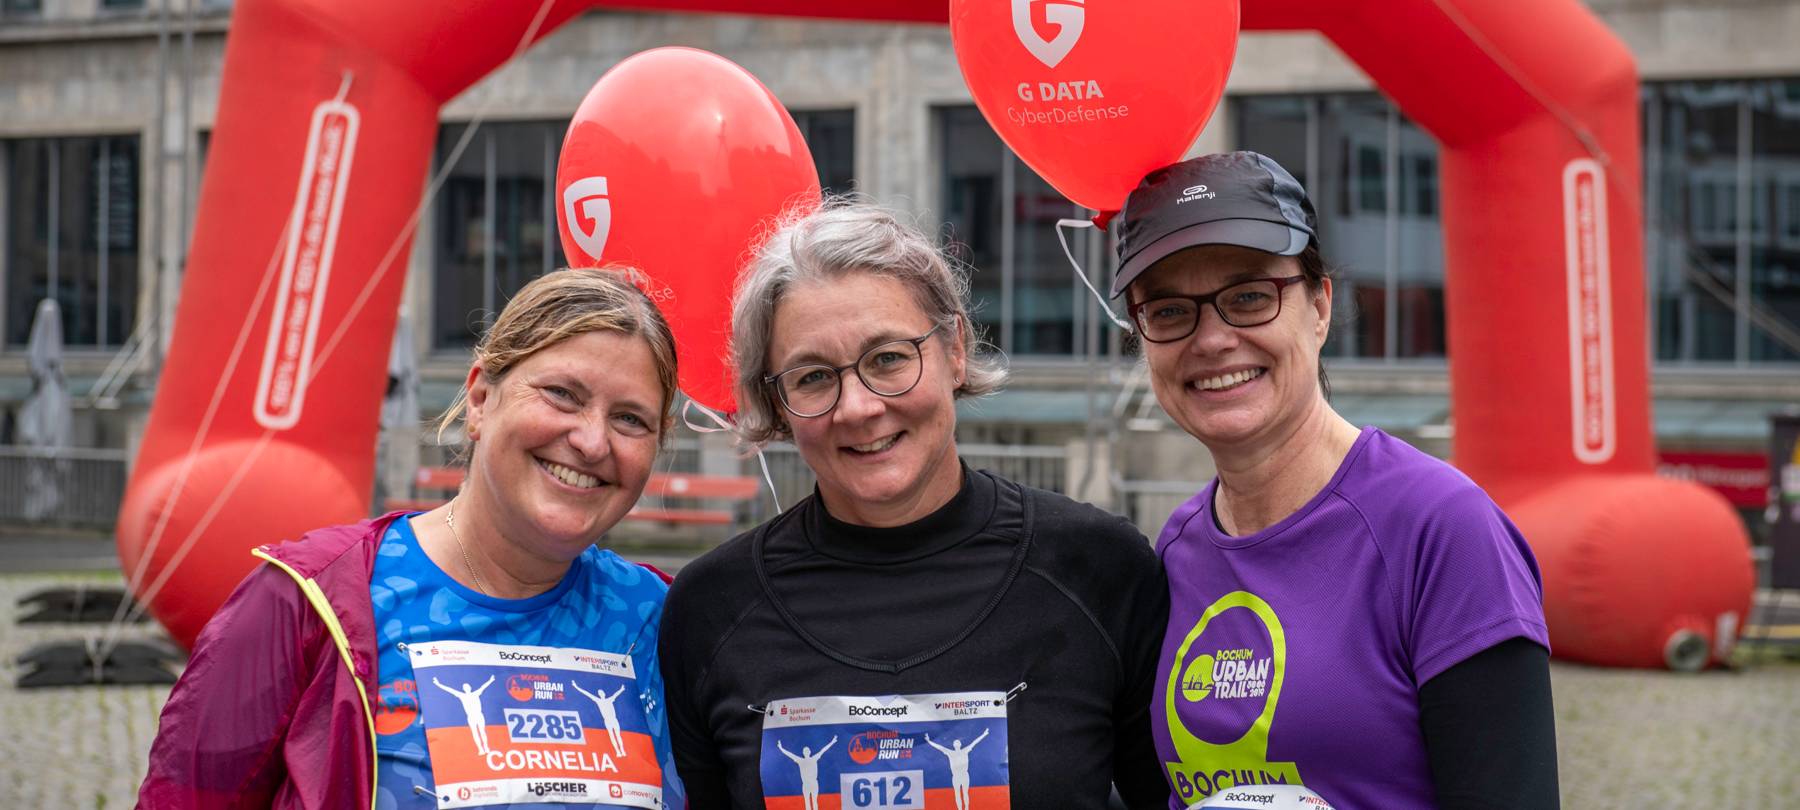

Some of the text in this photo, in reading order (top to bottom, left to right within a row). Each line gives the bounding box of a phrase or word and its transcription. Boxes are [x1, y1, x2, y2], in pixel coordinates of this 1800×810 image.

[1017, 79, 1104, 102] G DATA
[1007, 104, 1129, 127] CyberDefense
[499, 651, 553, 664] BoConcept
[1216, 649, 1253, 660] BOCHUM
[1212, 657, 1271, 682] URBAN
[533, 681, 564, 693] URBAN
[1215, 680, 1247, 699] TRAIL
[534, 691, 553, 700] RUN
[942, 700, 990, 709] INTERSPORT
[789, 707, 816, 715] Sparkasse
[849, 705, 908, 717] BoConcept
[954, 708, 978, 716] BALTZ
[507, 713, 582, 740] 2285
[867, 731, 898, 740] BOCHUM
[880, 739, 914, 750] URBAN
[878, 750, 899, 760] RUN
[486, 750, 618, 773] CORNELIA
[527, 782, 587, 797] LÖSCHER
[852, 776, 912, 807] 612
[1225, 793, 1275, 806] BoConcept
